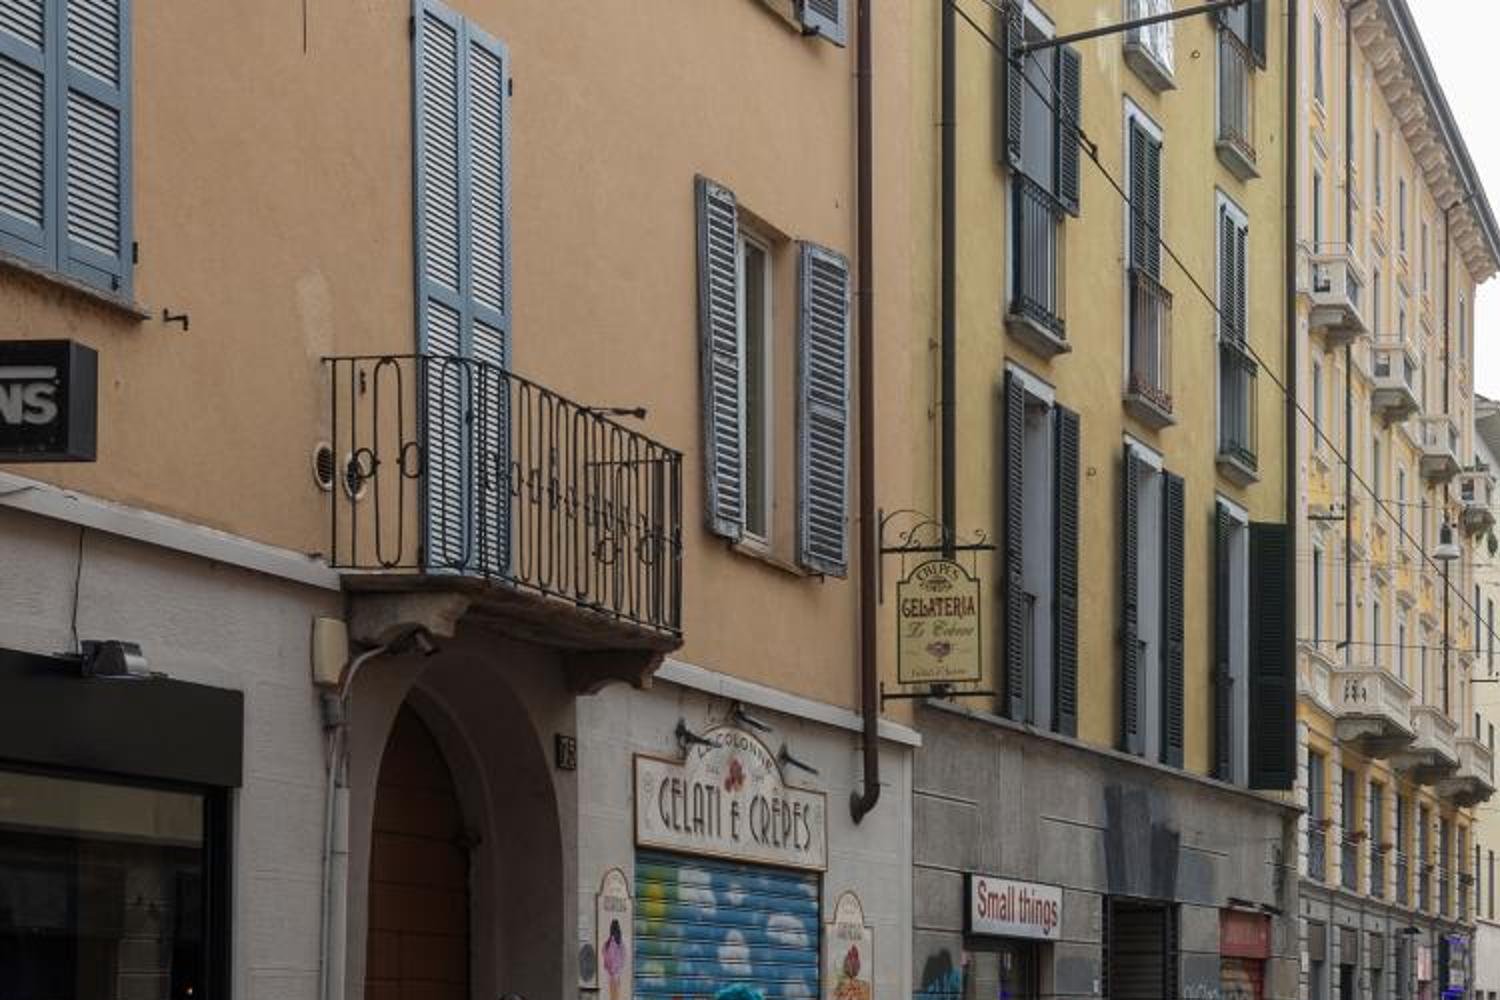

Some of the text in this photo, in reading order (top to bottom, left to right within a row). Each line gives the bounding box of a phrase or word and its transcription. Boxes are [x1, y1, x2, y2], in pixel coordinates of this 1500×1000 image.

[901, 596, 976, 620] GELATERIA
[658, 776, 722, 838] GELATI
[977, 880, 1057, 936] Small things
